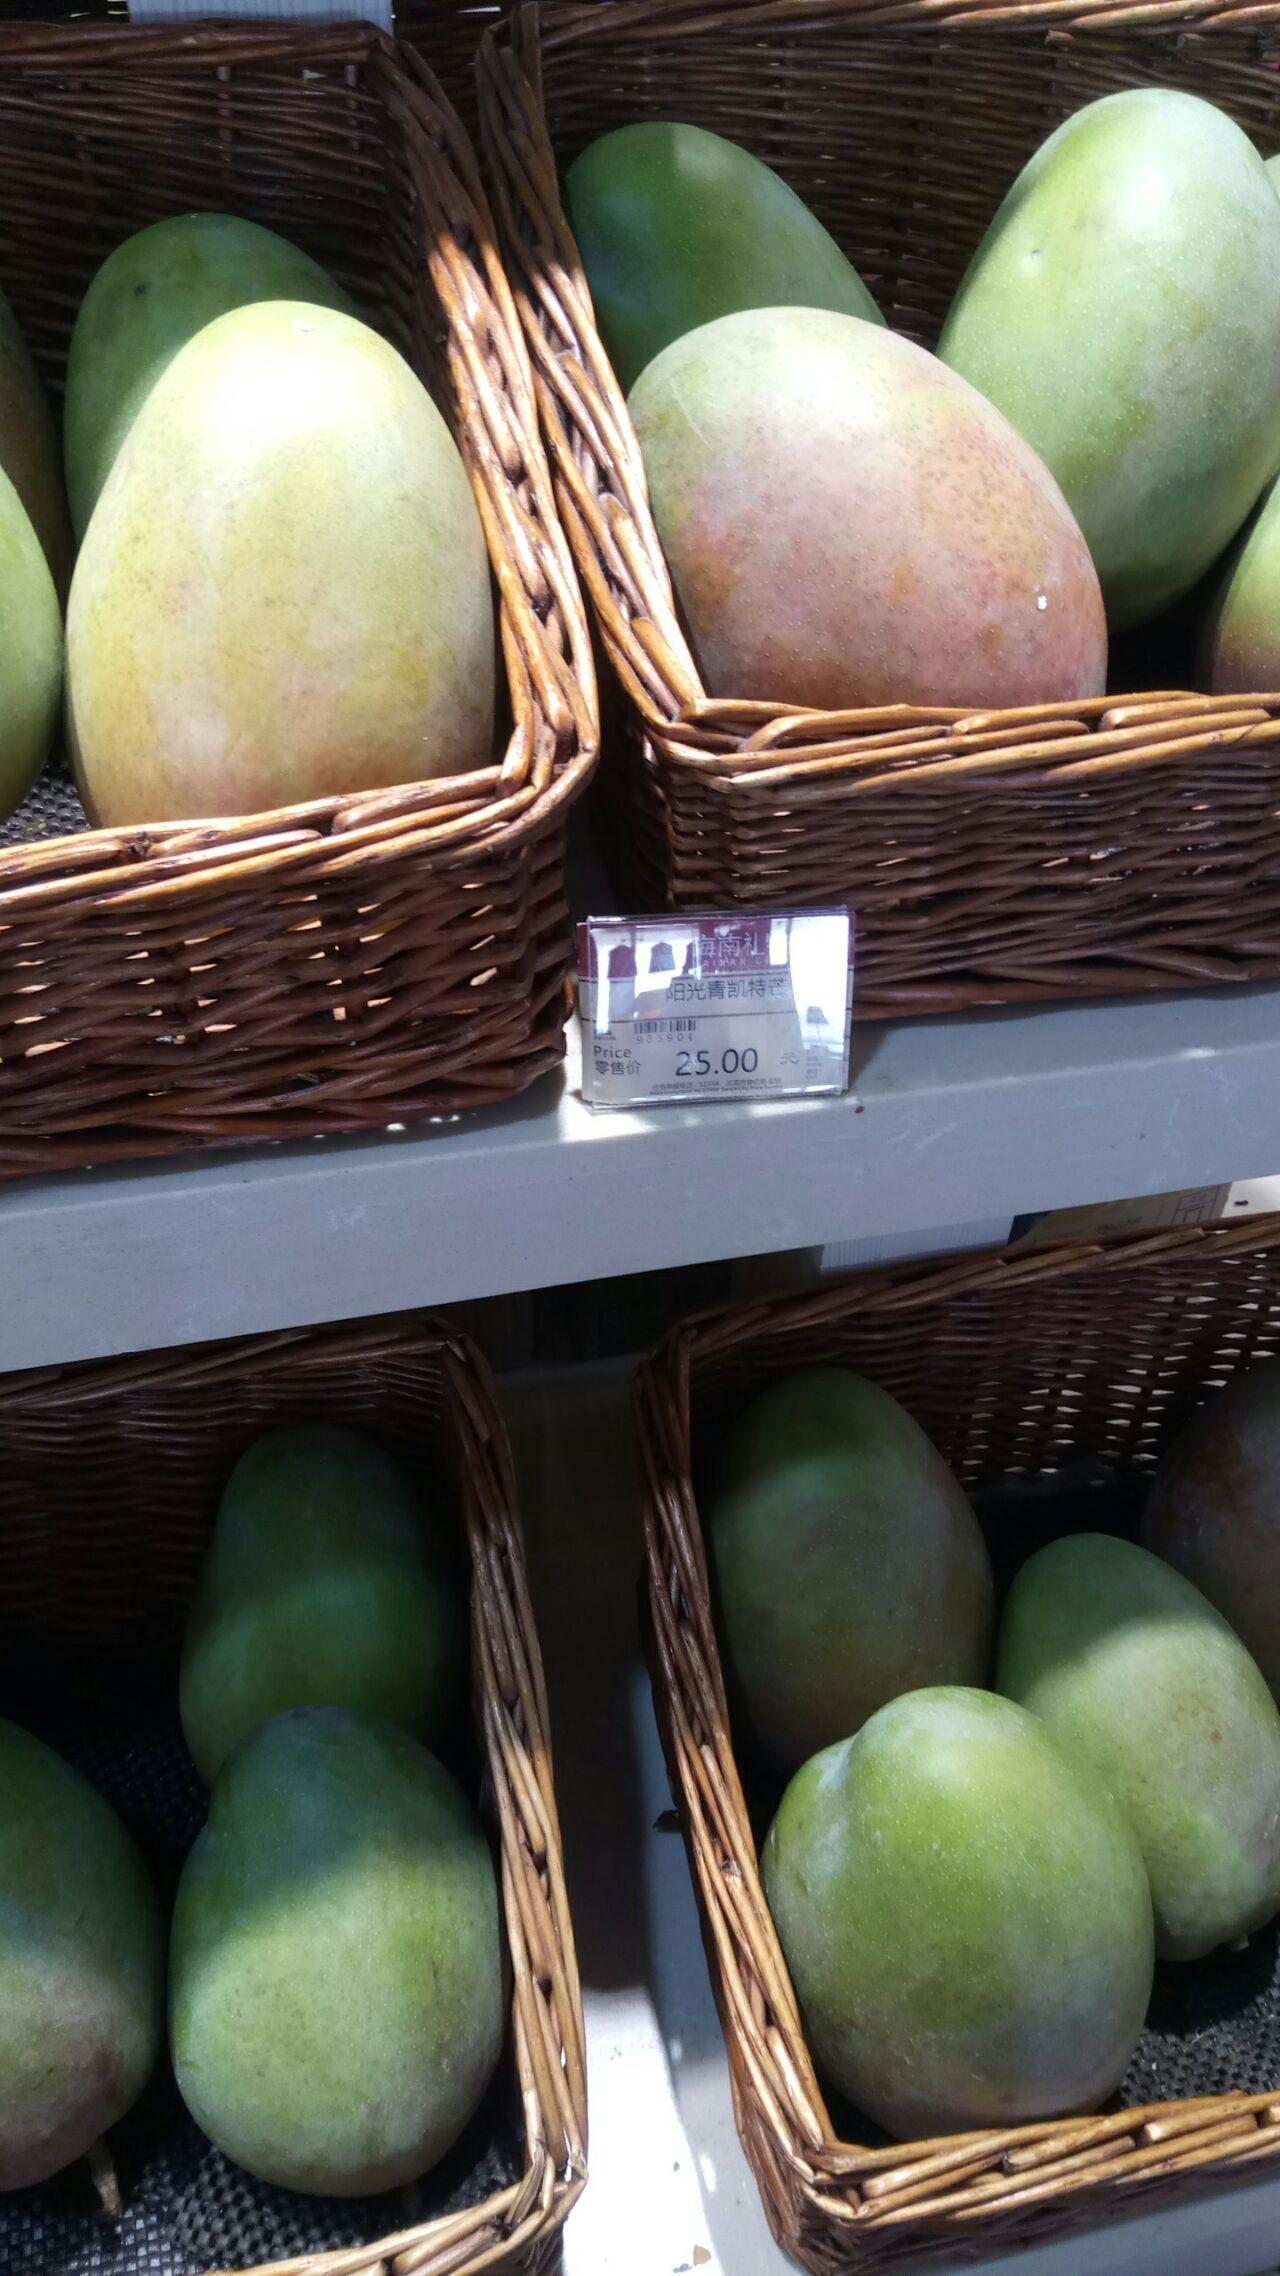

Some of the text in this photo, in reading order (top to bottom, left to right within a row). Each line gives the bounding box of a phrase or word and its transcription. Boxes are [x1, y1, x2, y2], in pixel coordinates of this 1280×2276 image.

[666, 976, 786, 1002] 阳光青凯特芒
[593, 1045, 632, 1059] Price
[675, 1048, 759, 1077] 25.00
[594, 1060, 641, 1076] 零售价
